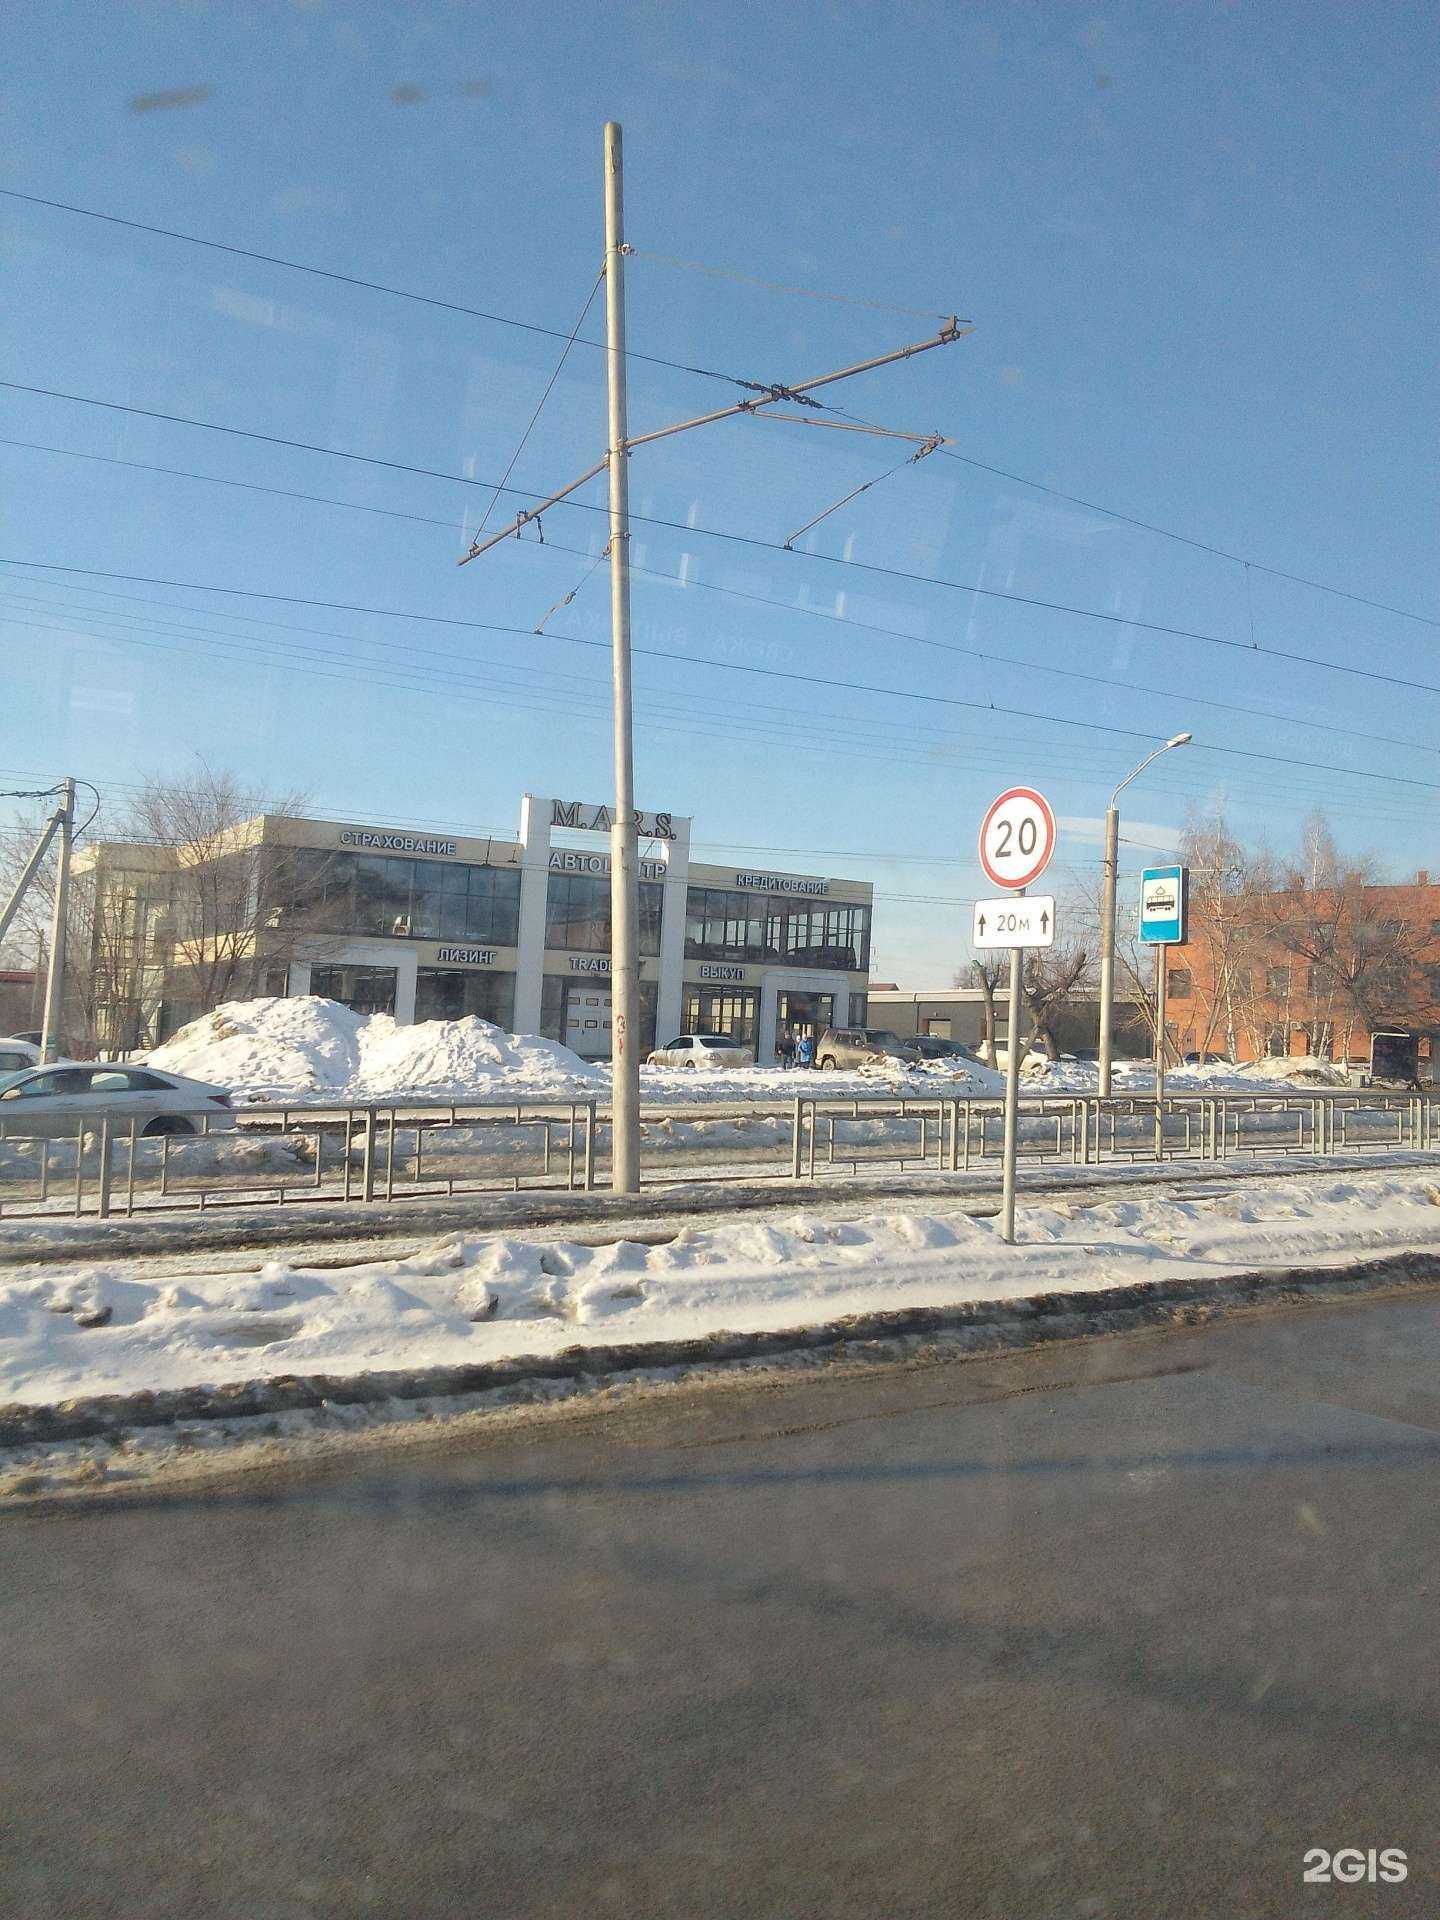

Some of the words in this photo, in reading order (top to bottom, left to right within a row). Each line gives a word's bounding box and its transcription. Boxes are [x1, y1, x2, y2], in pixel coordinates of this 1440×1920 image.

[550, 799, 677, 840] M.AR.S.
[340, 831, 457, 856] СТРАХОВАНИЕ
[995, 817, 1037, 858] 20
[549, 852, 667, 879] АВТОТР
[736, 873, 829, 896] КРЕДИТОВАНИЕ
[438, 948, 497, 965] ЛИЗИНГ
[701, 965, 745, 980] ВЫКУП
